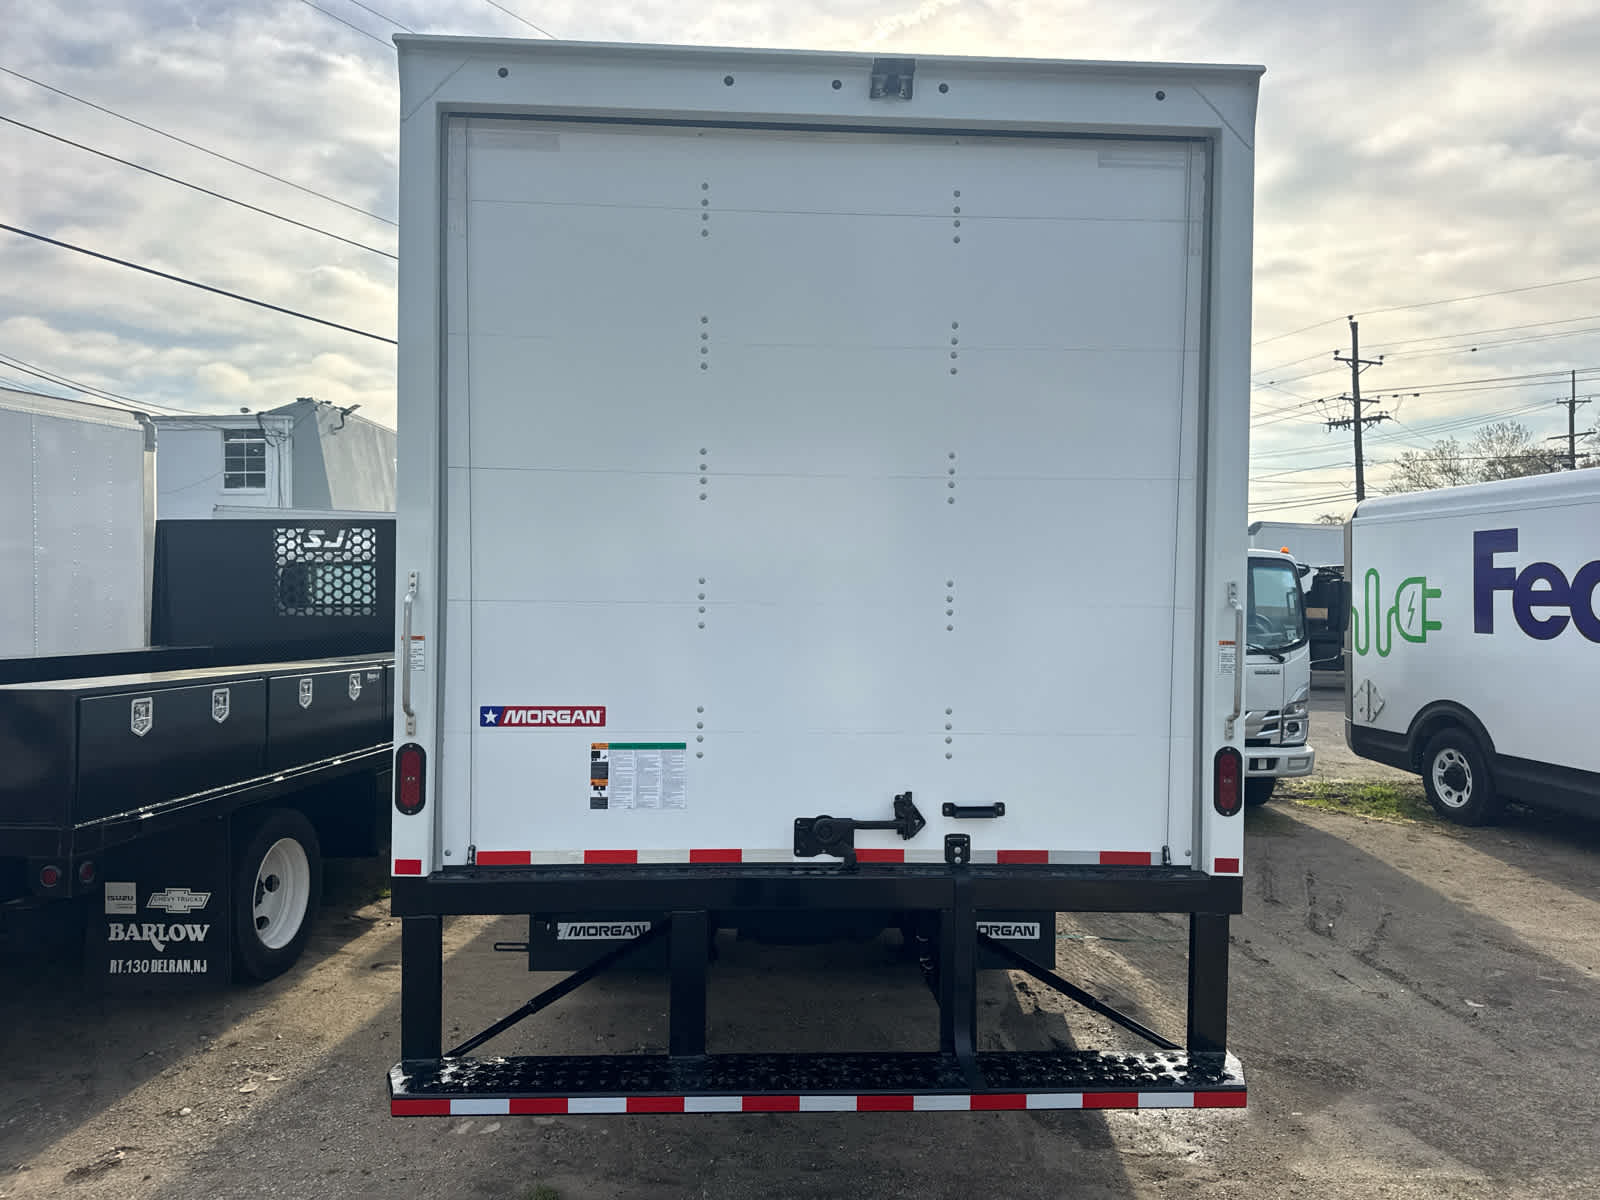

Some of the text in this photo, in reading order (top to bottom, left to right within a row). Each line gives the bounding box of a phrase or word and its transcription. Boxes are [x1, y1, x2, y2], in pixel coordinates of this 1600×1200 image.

[302, 529, 346, 548] SJ
[504, 709, 601, 725] MORGAN
[108, 923, 210, 952] BARLOW
[567, 924, 646, 937] MORGAN
[978, 925, 1035, 937] ORGAN
